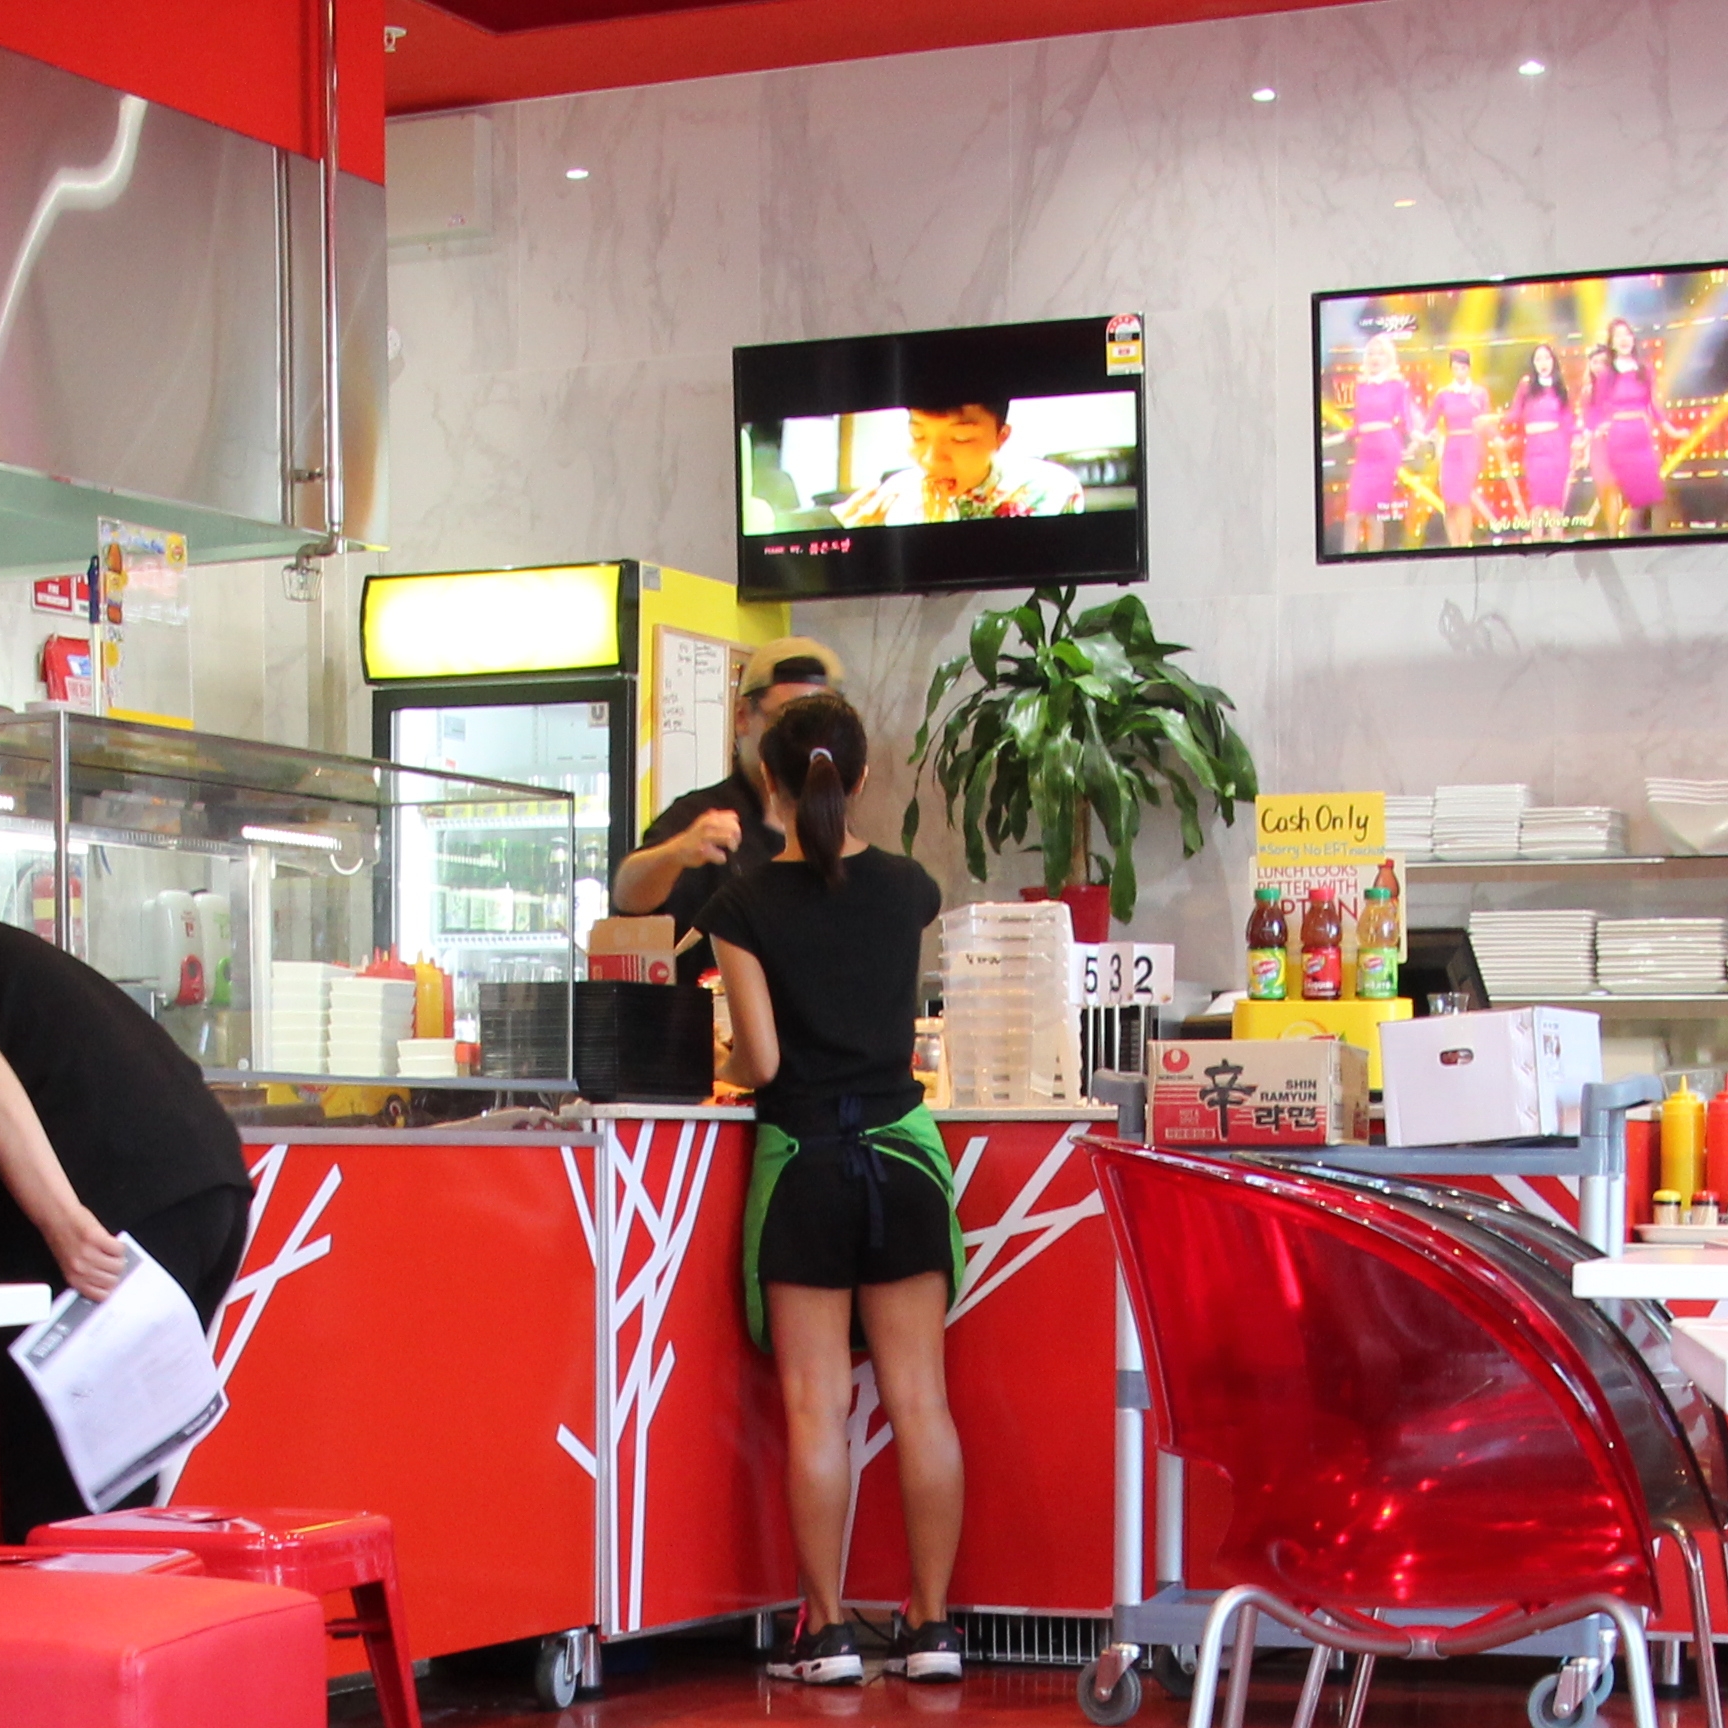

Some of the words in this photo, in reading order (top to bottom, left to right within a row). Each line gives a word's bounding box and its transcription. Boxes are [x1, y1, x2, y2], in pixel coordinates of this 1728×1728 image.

[1261, 806, 1310, 834] Cash
[1316, 804, 1369, 843] Only
[1304, 843, 1321, 856] No
[1324, 842, 1348, 857] EFT
[1257, 866, 1304, 879] LUNCH
[1309, 865, 1358, 878] LOOKS
[1084, 956, 1098, 994] 5
[1110, 953, 1122, 993] 3
[1134, 955, 1153, 993] 2
[1199, 1058, 1258, 1141] 辛
[1260, 1091, 1317, 1102] RAMYUN
[1286, 1079, 1317, 1089] SHIN
[1253, 1104, 1318, 1134] 라면
